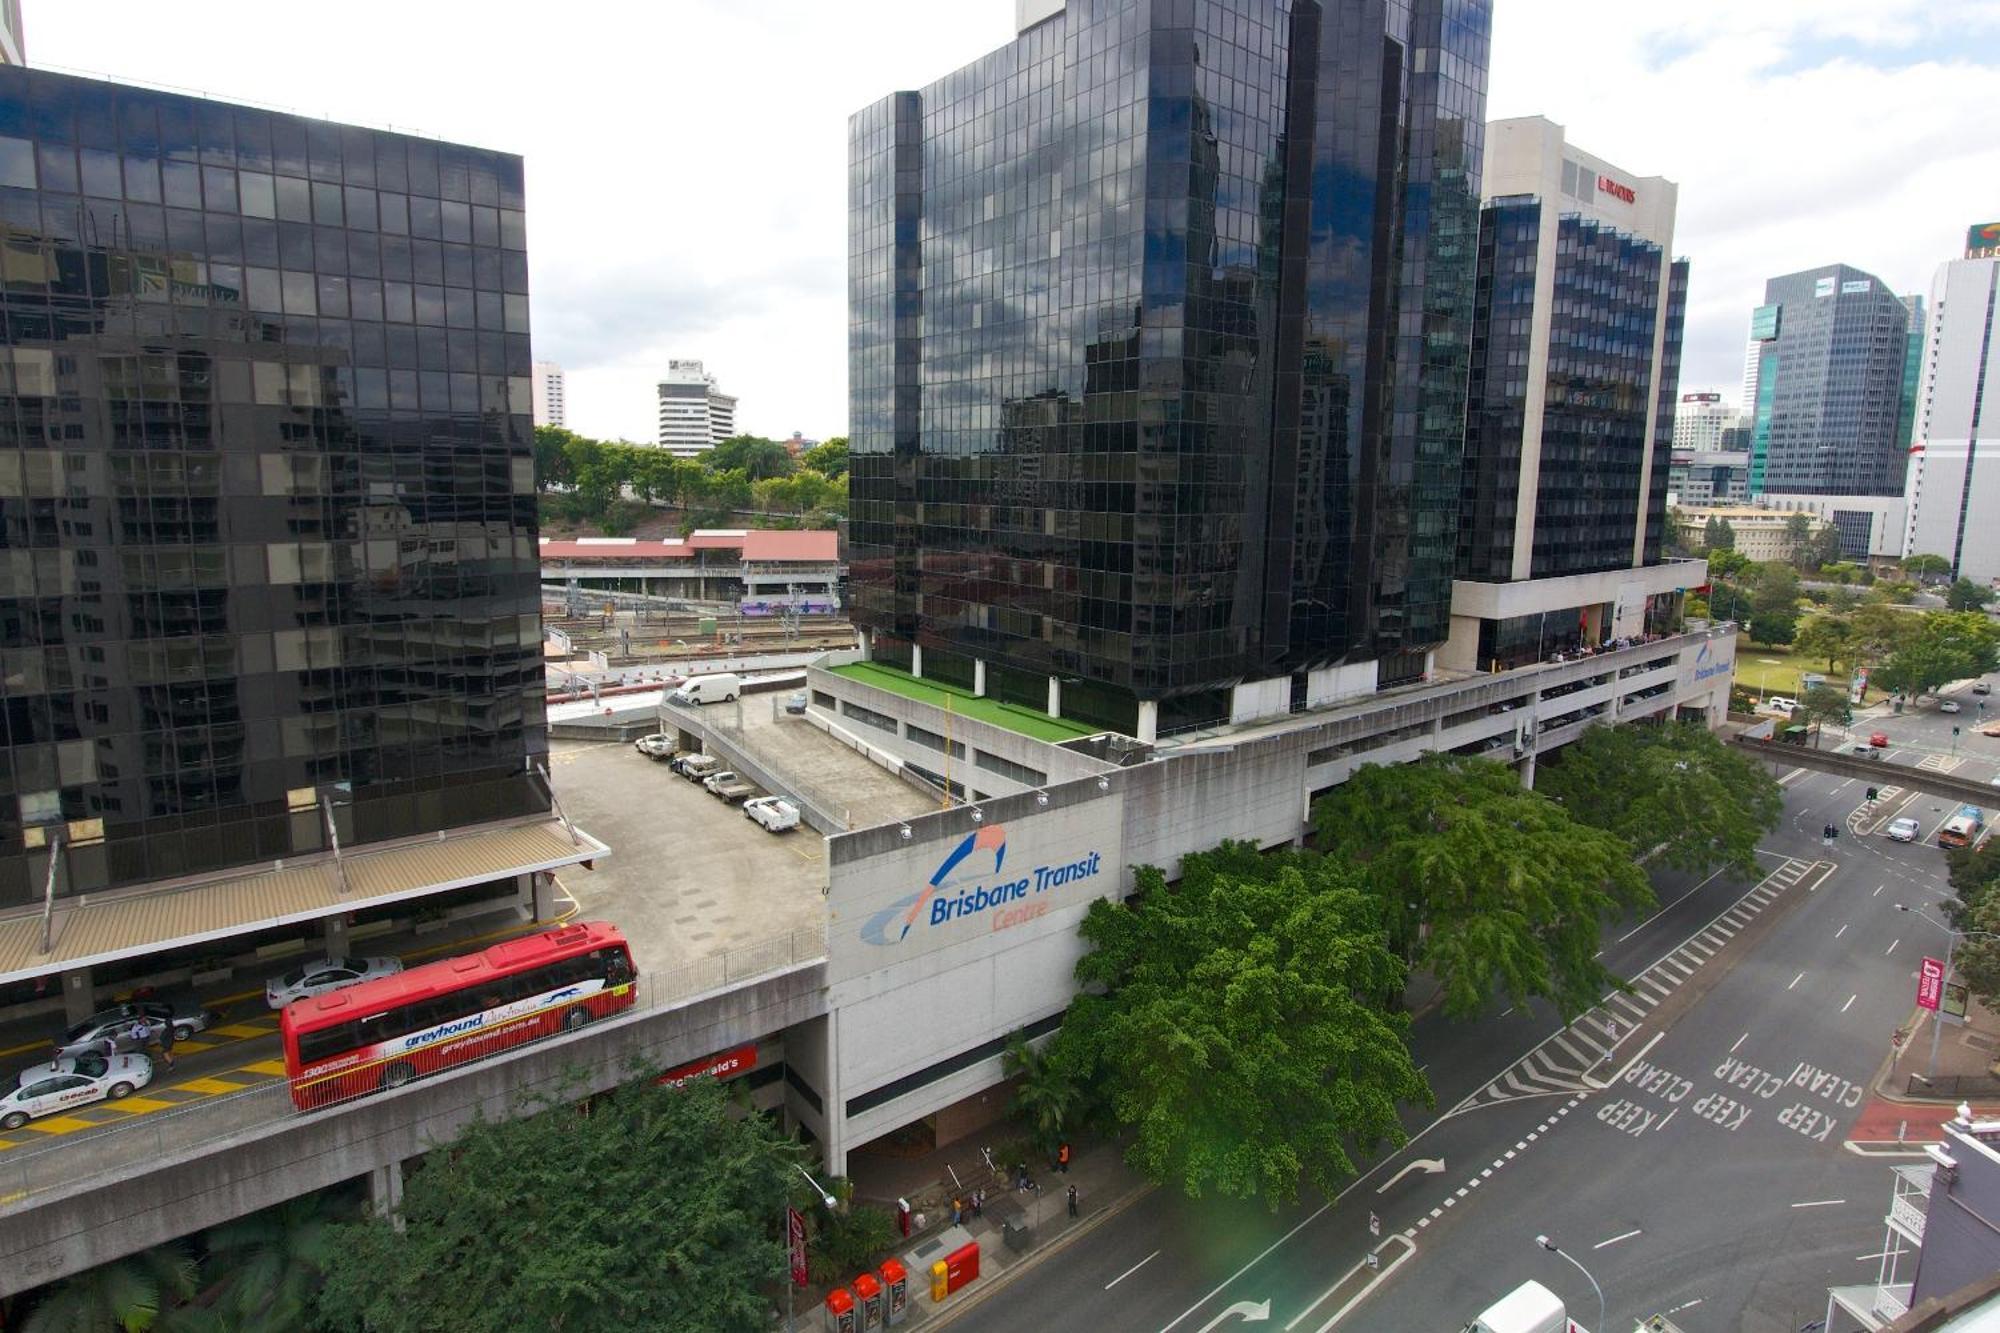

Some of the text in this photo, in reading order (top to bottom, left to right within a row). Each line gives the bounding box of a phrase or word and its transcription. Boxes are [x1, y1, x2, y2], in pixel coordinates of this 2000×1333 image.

[930, 850, 1101, 926] Brisbane Transit
[992, 900, 1048, 932] Centre
[405, 1014, 483, 1050] greyhound
[1624, 1060, 1694, 1102] CLEAR
[1713, 1056, 1783, 1098] CLEAR
[1795, 1062, 1863, 1108] CLEAR
[1596, 1099, 1658, 1137] KEEP
[1692, 1092, 1752, 1131] KEEP
[1777, 1103, 1837, 1141] KEEP
